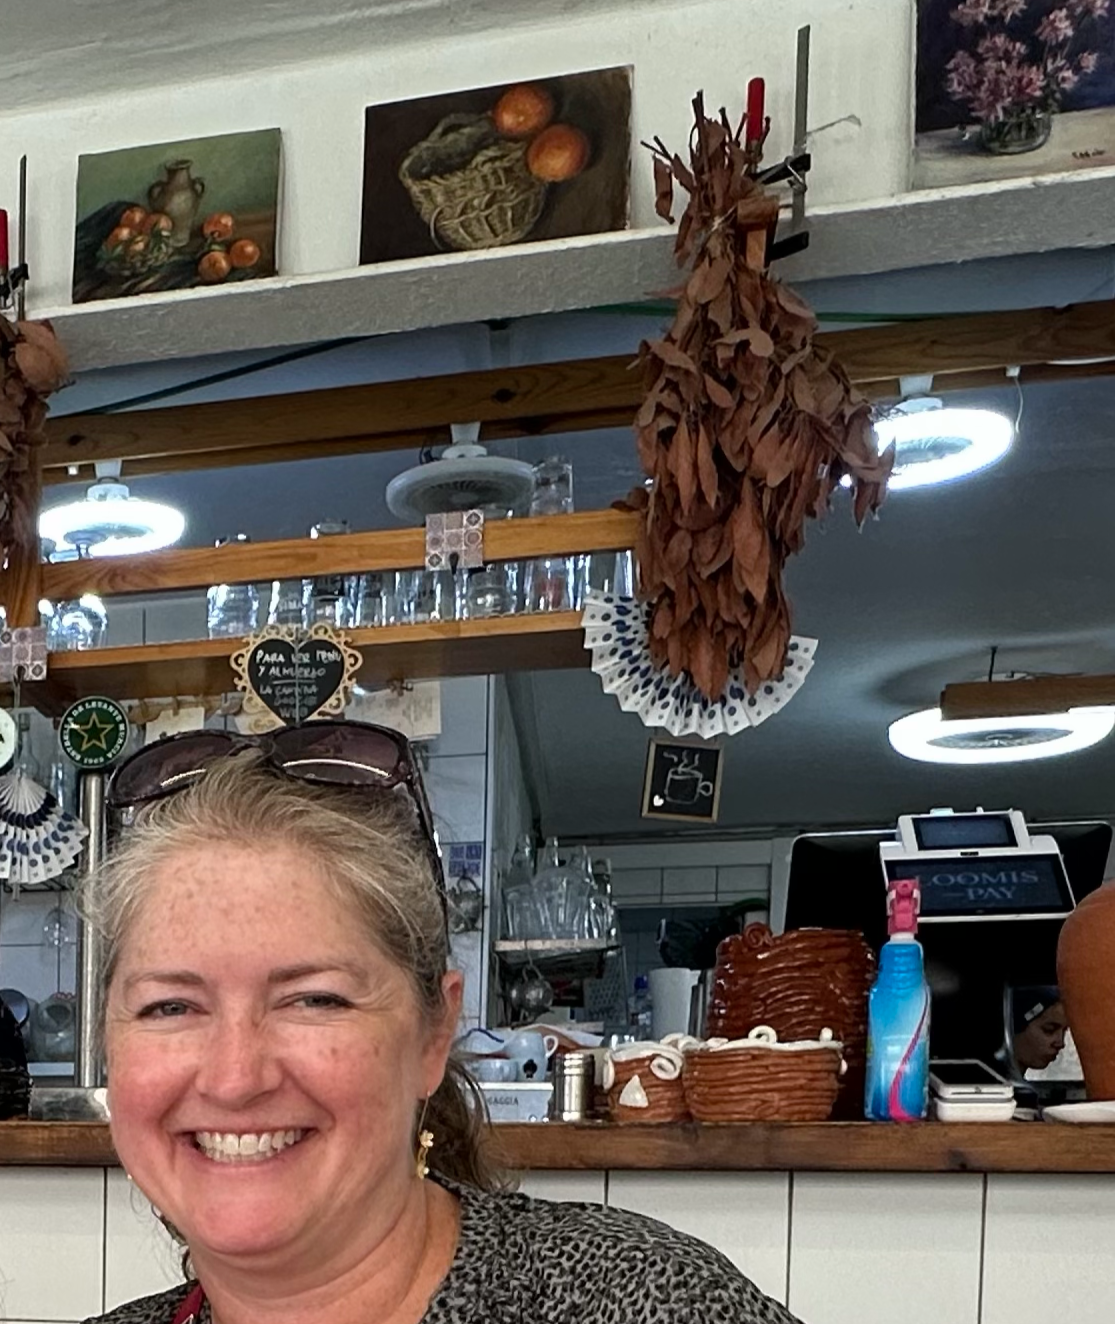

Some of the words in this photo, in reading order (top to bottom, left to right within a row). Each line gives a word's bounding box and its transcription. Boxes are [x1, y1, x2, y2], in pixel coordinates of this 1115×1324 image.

[256, 649, 285, 664] PARA
[291, 652, 311, 664] VER
[258, 665, 266, 677] Y
[259, 684, 273, 695] LA
[72, 705, 85, 717] DE
[85, 701, 122, 722] LEVANTE
[106, 723, 125, 758] MURCIA
[966, 886, 1016, 901] PAY
